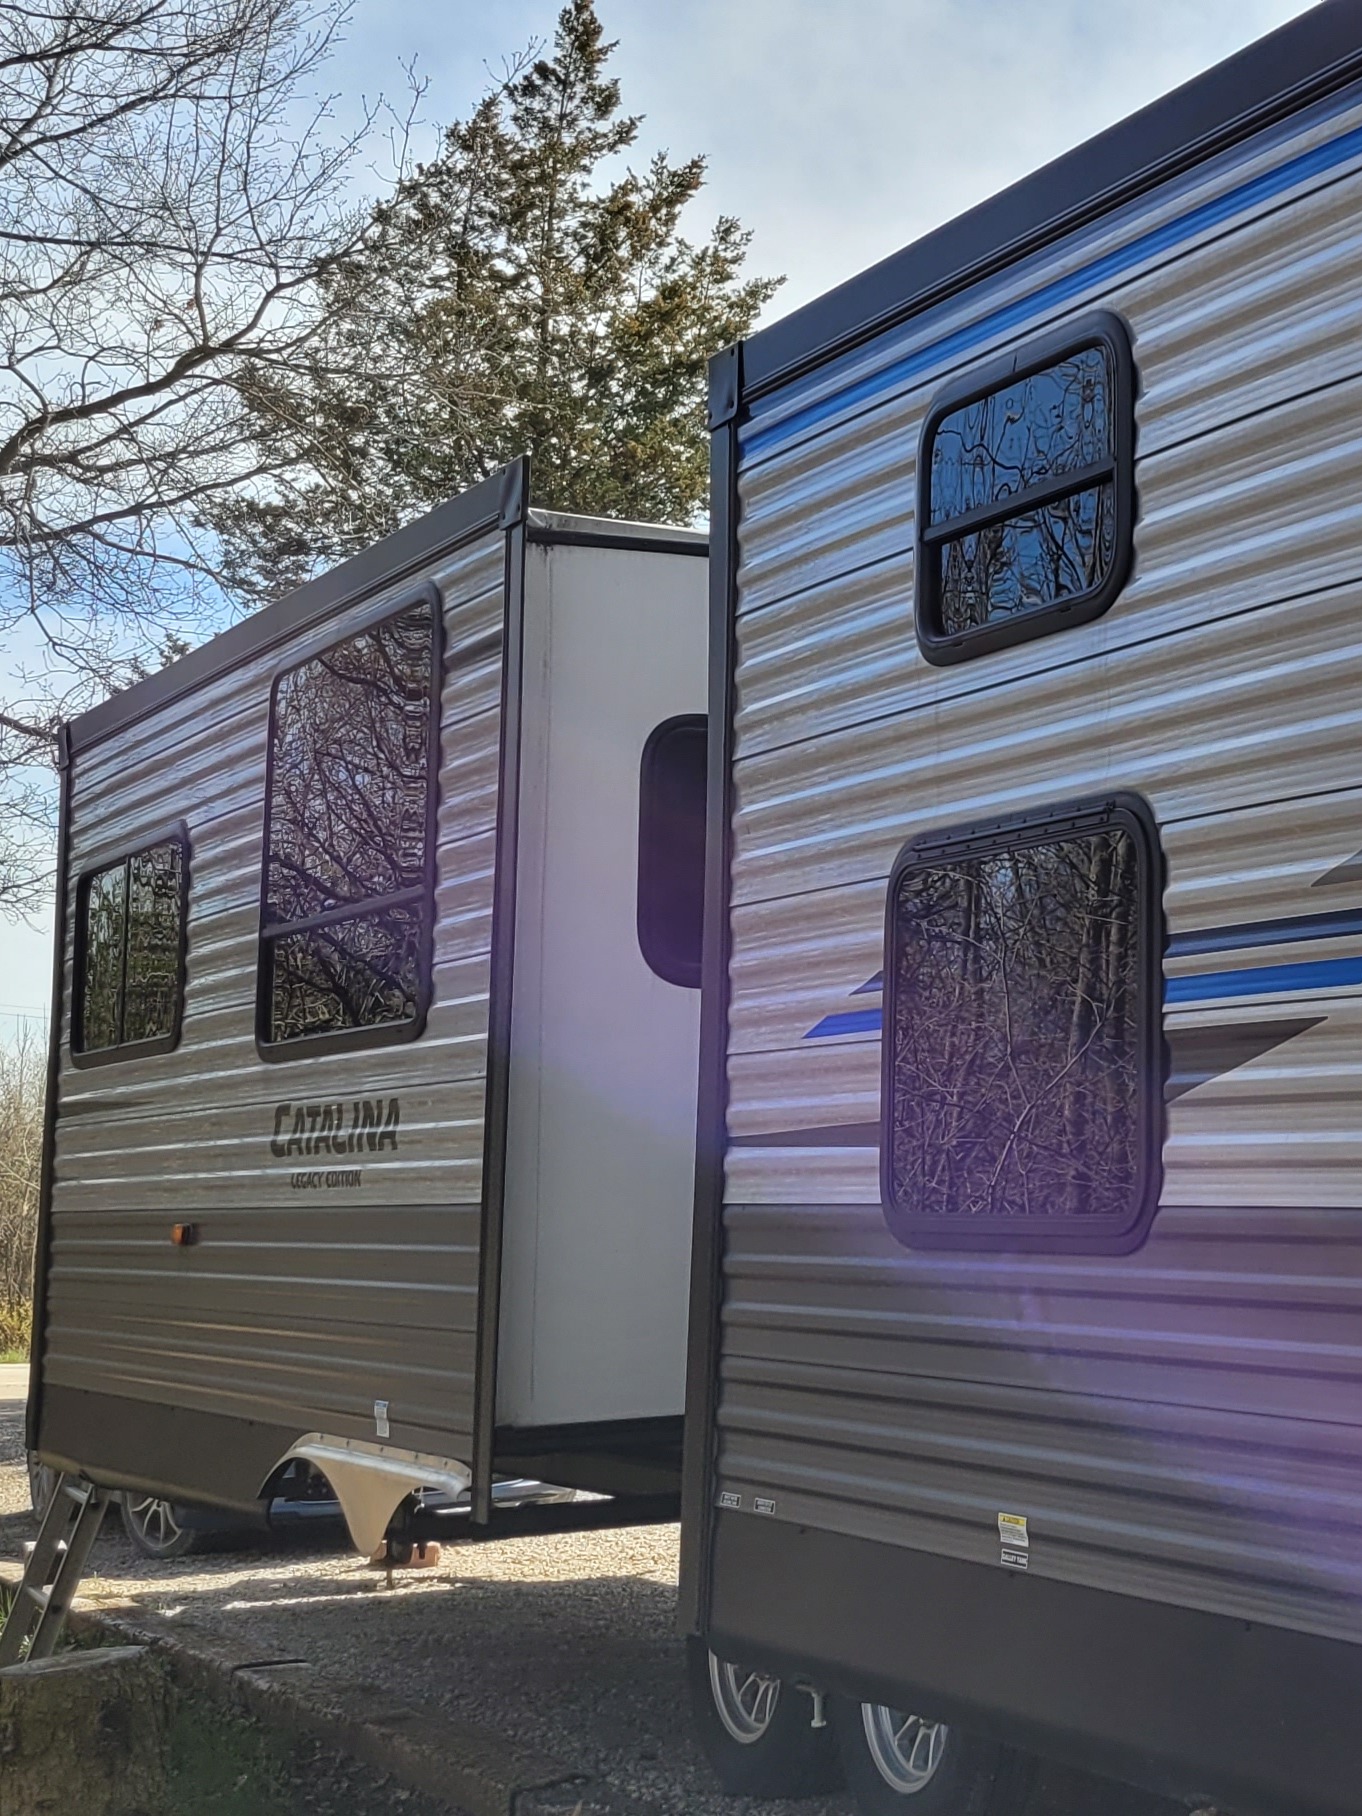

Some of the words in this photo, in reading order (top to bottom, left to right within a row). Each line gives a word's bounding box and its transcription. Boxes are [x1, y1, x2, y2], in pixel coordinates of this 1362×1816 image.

[270, 1098, 399, 1157] CATALINA
[291, 1172, 323, 1189] LEGACY
[325, 1170, 361, 1188] EDITION
